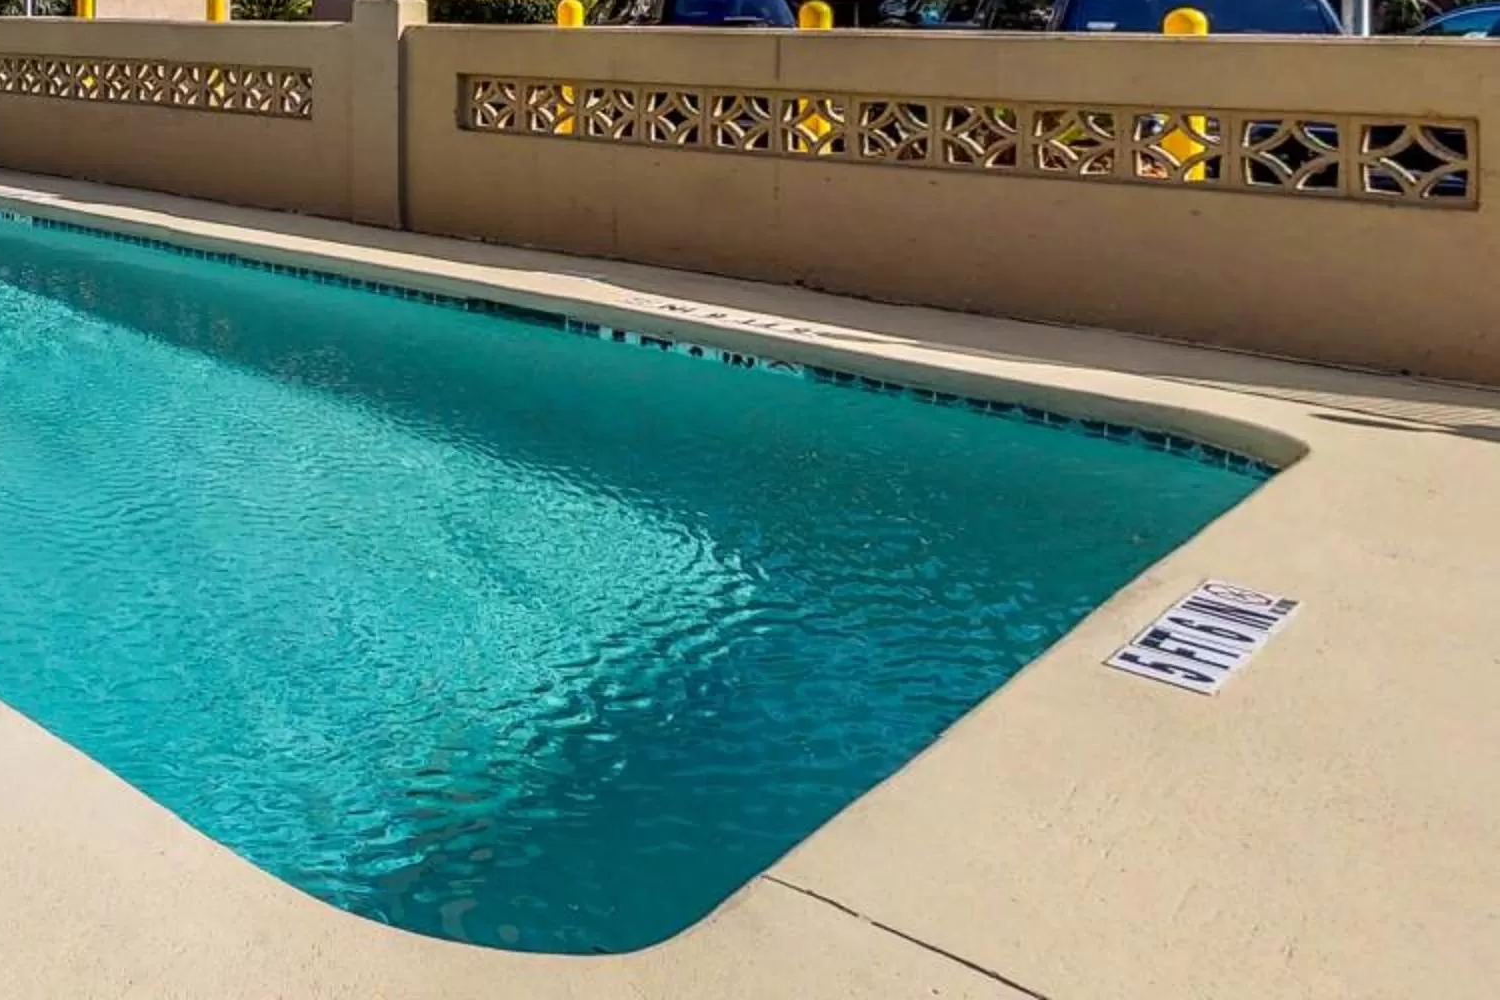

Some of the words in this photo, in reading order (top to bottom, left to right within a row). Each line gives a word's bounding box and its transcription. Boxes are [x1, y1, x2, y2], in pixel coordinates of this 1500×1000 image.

[1181, 596, 1280, 630] IN
[1166, 616, 1256, 643] 6
[1138, 628, 1241, 670] FT
[1117, 652, 1215, 683] 5
